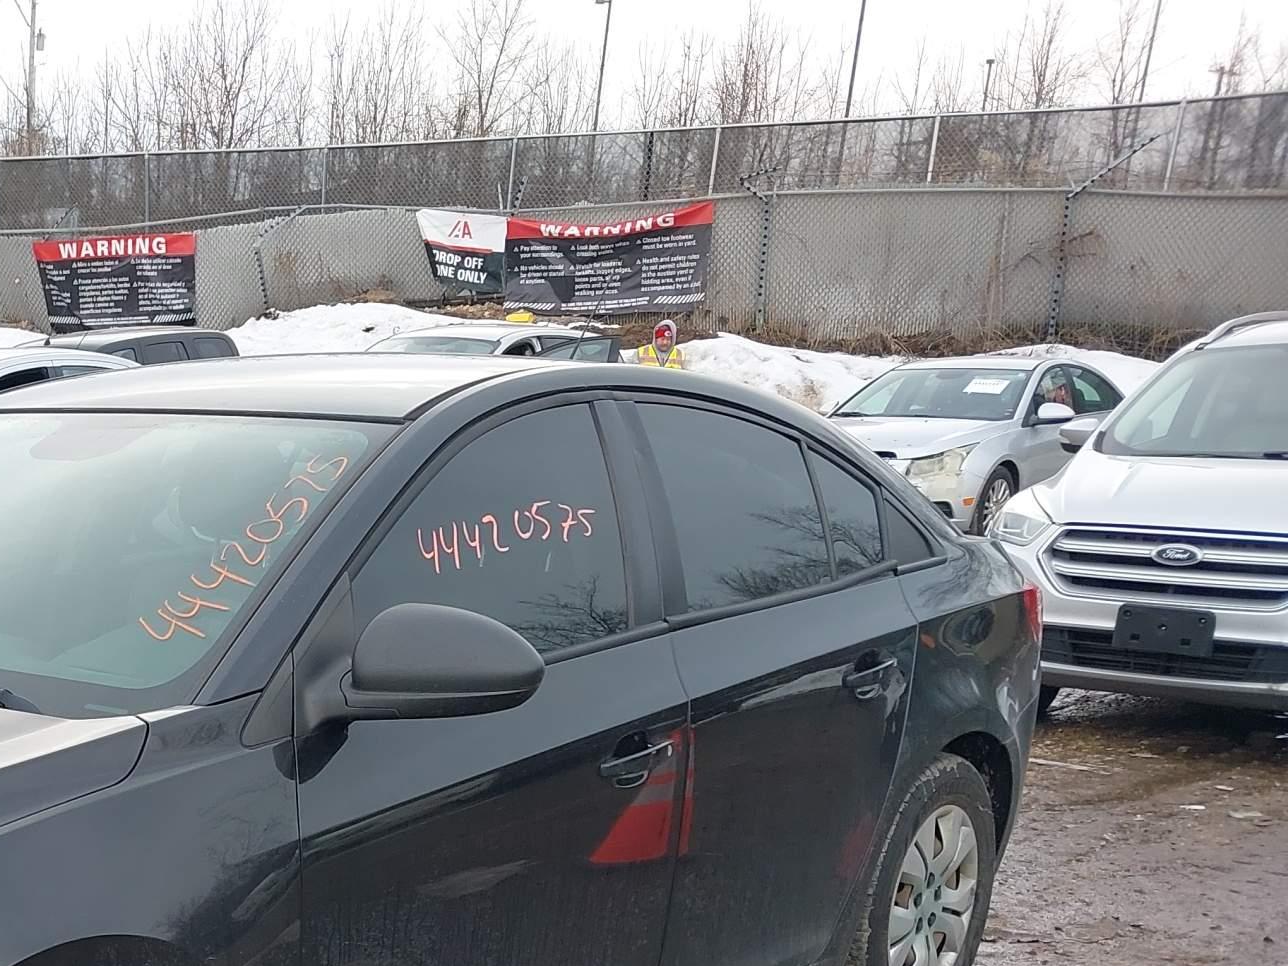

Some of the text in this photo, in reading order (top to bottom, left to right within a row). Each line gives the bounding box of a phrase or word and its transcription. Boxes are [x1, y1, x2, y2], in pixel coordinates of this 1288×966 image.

[58, 236, 167, 259] WARNING
[435, 264, 487, 284] NE ONLY
[464, 256, 484, 269] OFF
[139, 454, 349, 641] 44420575
[417, 499, 597, 574] 44420575
